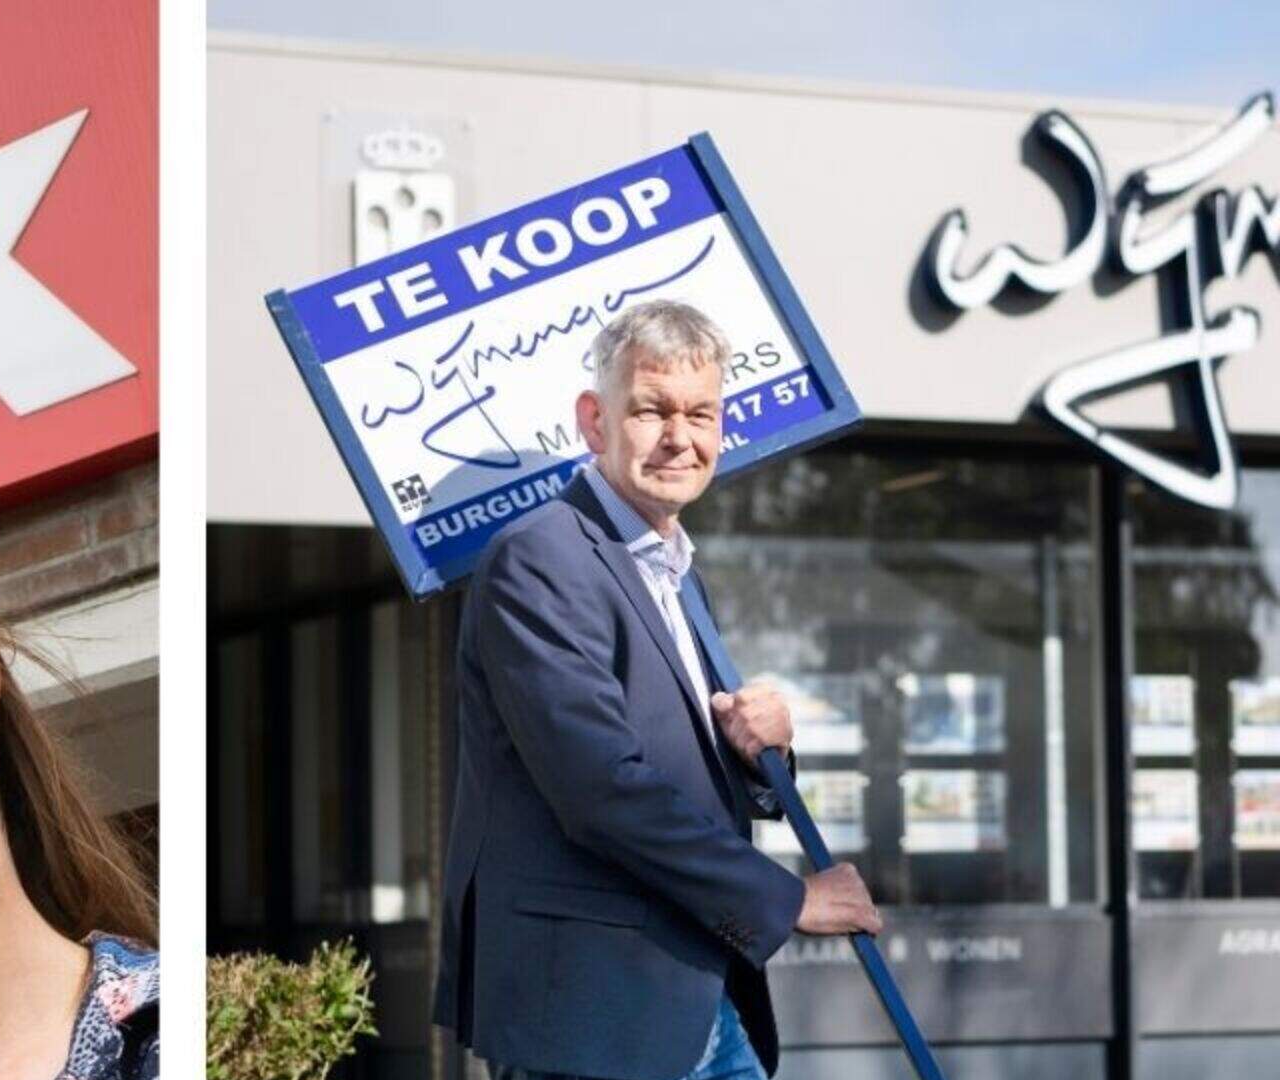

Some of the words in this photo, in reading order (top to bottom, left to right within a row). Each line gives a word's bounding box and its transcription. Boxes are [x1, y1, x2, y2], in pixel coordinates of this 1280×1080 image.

[333, 262, 449, 334] TE
[457, 174, 672, 292] KOOP
[726, 392, 762, 423] 17
[772, 373, 810, 406] 57
[415, 472, 566, 548] BURGUM
